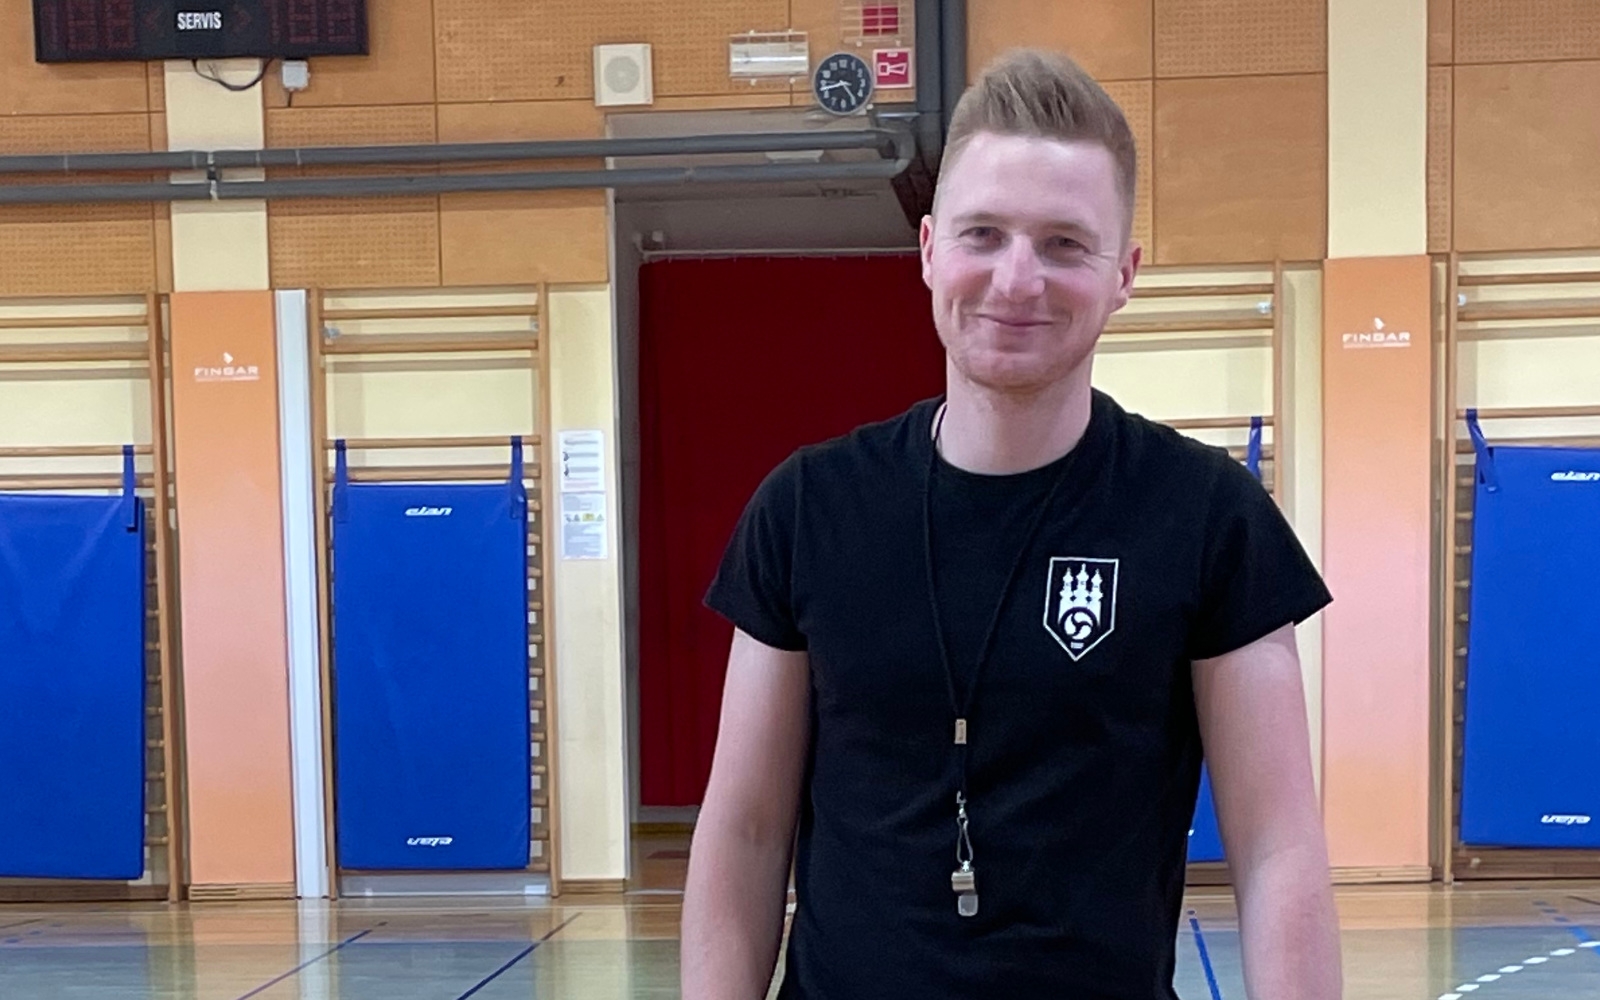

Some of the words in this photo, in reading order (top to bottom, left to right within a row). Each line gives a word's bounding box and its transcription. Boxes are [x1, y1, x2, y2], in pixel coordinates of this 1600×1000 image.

[177, 12, 222, 30] SERVIS
[839, 59, 847, 69] 12
[405, 506, 453, 516] elan
